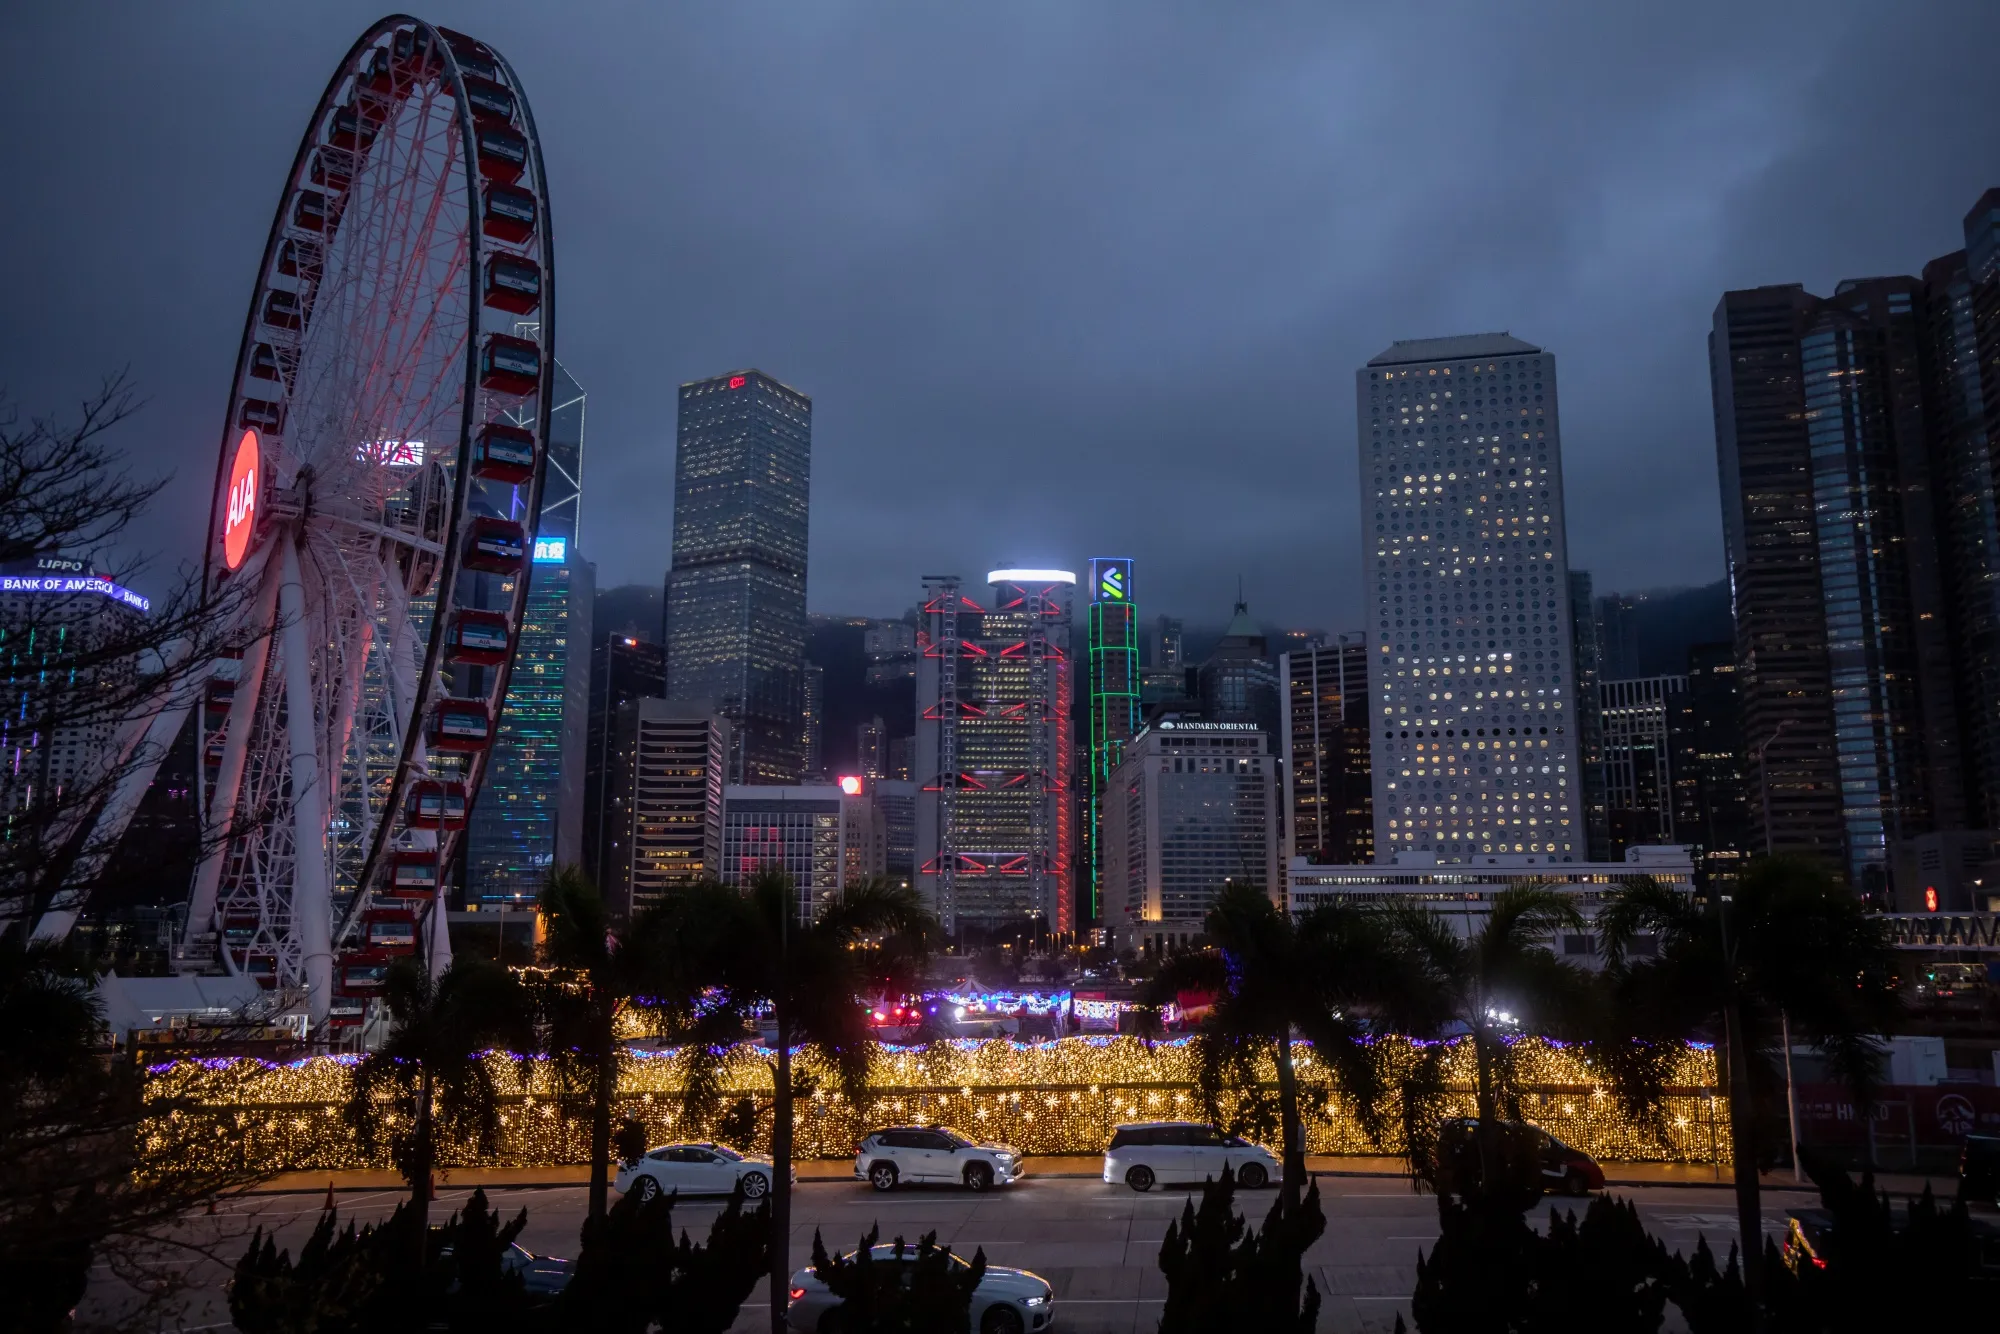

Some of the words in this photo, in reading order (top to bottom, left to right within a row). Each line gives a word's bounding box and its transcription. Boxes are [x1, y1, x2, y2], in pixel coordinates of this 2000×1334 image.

[226, 469, 255, 535] AIA
[37, 559, 83, 571] LIPPO
[3, 579, 40, 590] BANK
[43, 579, 63, 590] OF
[65, 579, 114, 595] AMERICA
[124, 591, 143, 607] BANK
[1176, 722, 1219, 730] MANDARIN
[1219, 722, 1259, 731] ORIENTAL
[1940, 1120, 1973, 1136] AIA
